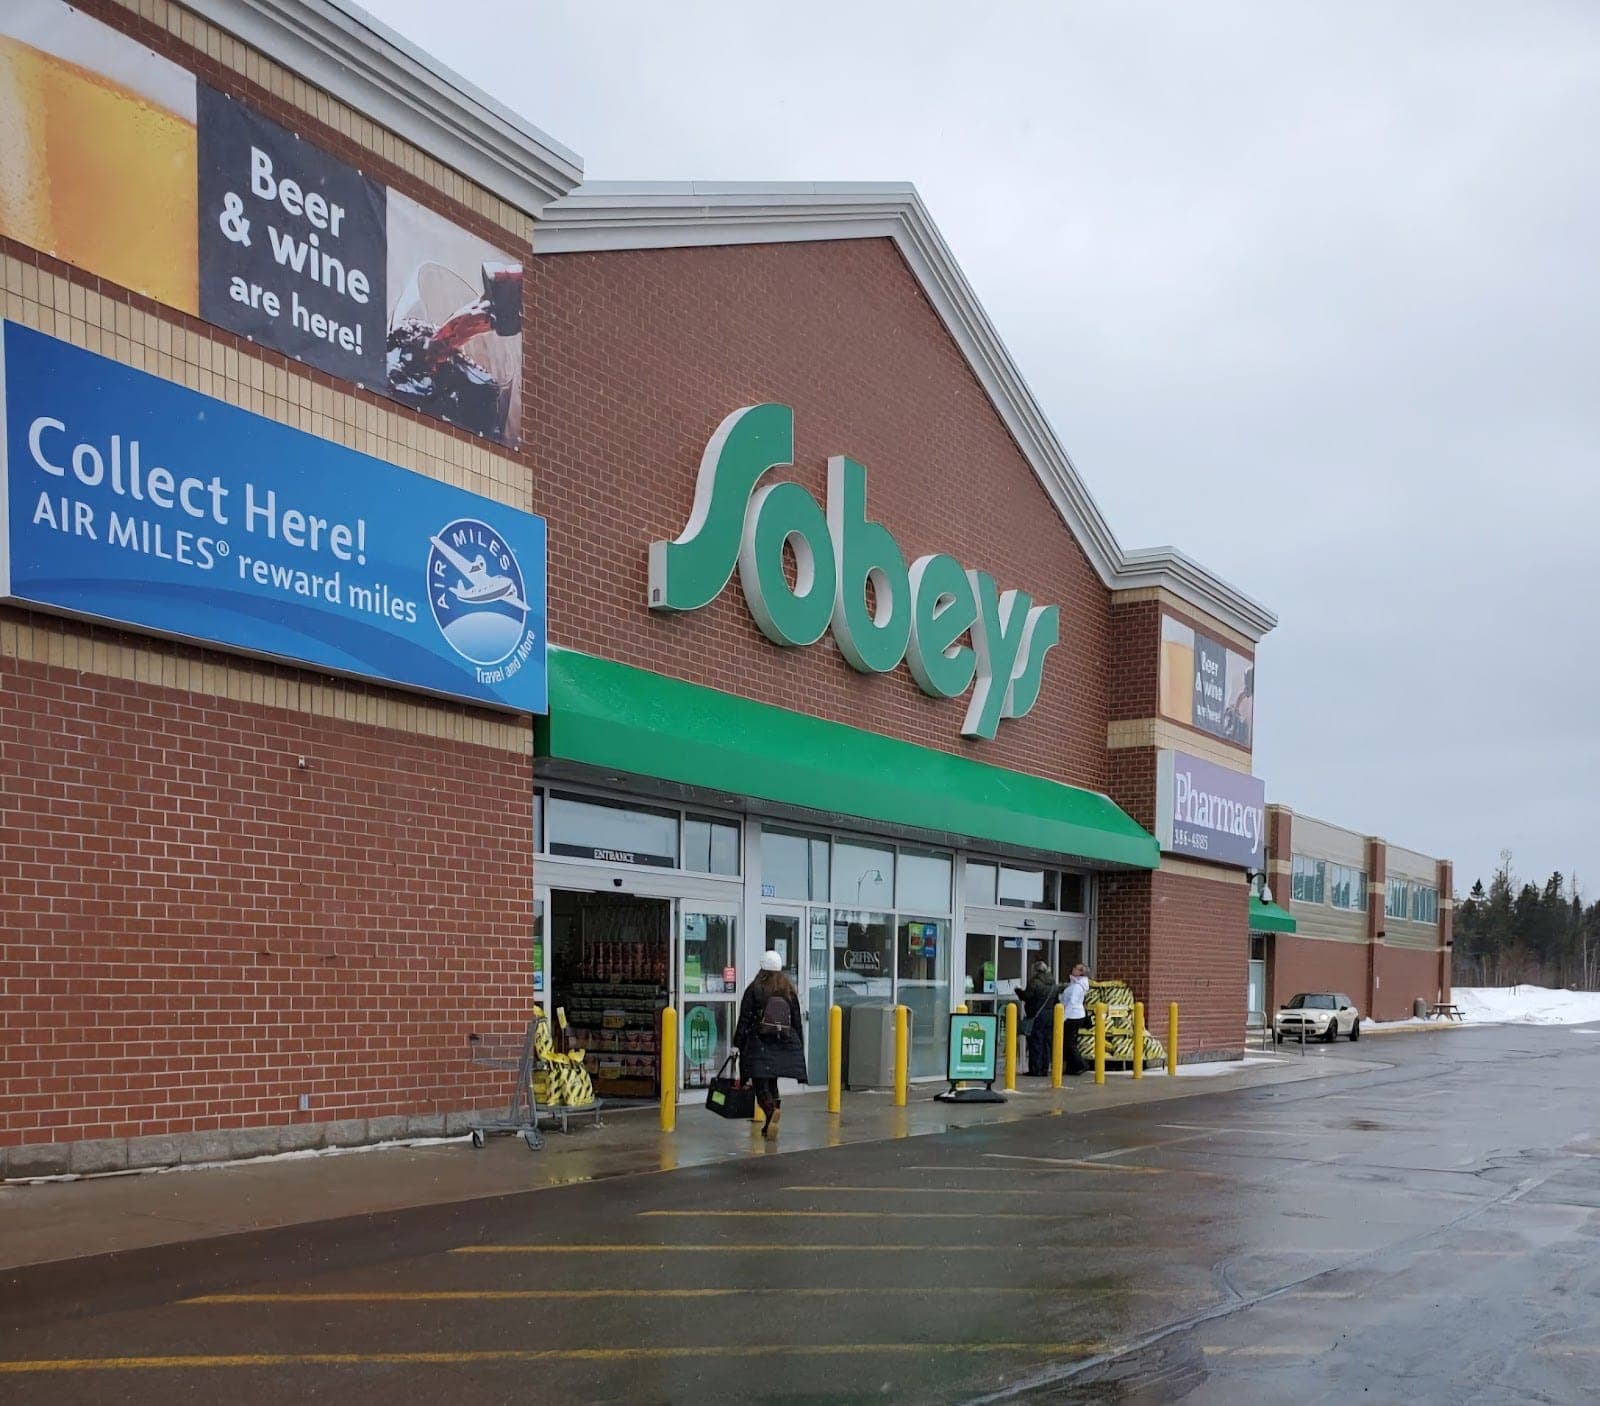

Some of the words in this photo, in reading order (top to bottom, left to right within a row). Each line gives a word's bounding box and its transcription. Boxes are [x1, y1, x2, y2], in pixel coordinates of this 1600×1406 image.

[251, 145, 345, 238] Beer
[219, 192, 252, 247] &
[267, 225, 370, 304] wine
[229, 276, 281, 318] are
[292, 291, 363, 356] here!
[28, 416, 229, 525] Collect
[246, 483, 366, 565] Here!
[33, 491, 98, 540] AIR
[238, 555, 341, 604] reward
[349, 583, 417, 624] miles
[434, 559, 448, 610] AIR
[452, 528, 511, 571] MILES
[648, 403, 1060, 741] Sobeys
[475, 666, 505, 684] Travel
[505, 655, 521, 679] and
[517, 629, 535, 662] More
[1174, 771, 1263, 855] Pharmacy
